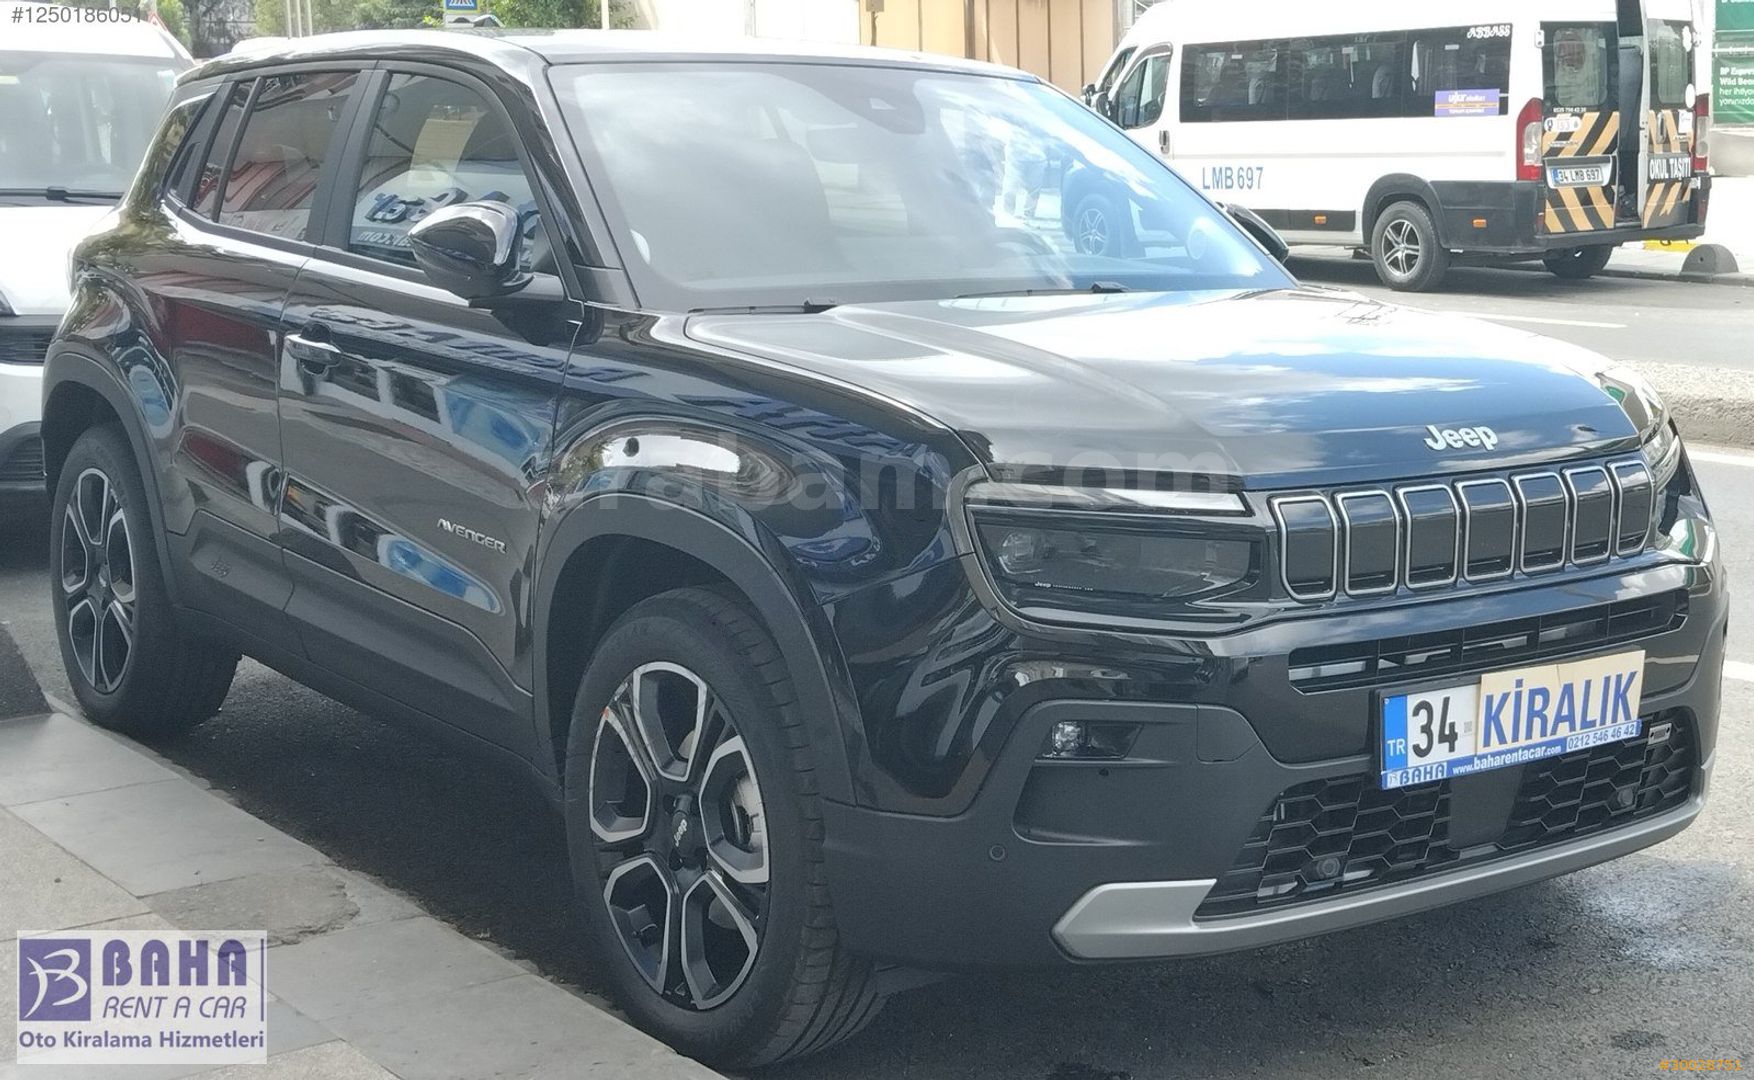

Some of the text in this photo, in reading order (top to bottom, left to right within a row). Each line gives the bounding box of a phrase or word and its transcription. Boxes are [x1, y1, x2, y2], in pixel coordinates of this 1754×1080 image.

[1467, 24, 1511, 39] ABBASS
[1202, 166, 1263, 190] LMB 697
[1558, 168, 1600, 182] 34 LMB 697
[1650, 157, 1690, 181] OKUL TAŞITI
[1423, 424, 1498, 451] Jeep
[437, 518, 507, 555] AVENGER
[1482, 670, 1639, 748] KİRALIK
[1412, 696, 1458, 758] 34
[1568, 724, 1636, 750] 0212 546 46 42
[1387, 738, 1406, 756] TR
[1400, 745, 1562, 785] BAHA www.baharentacar.com
